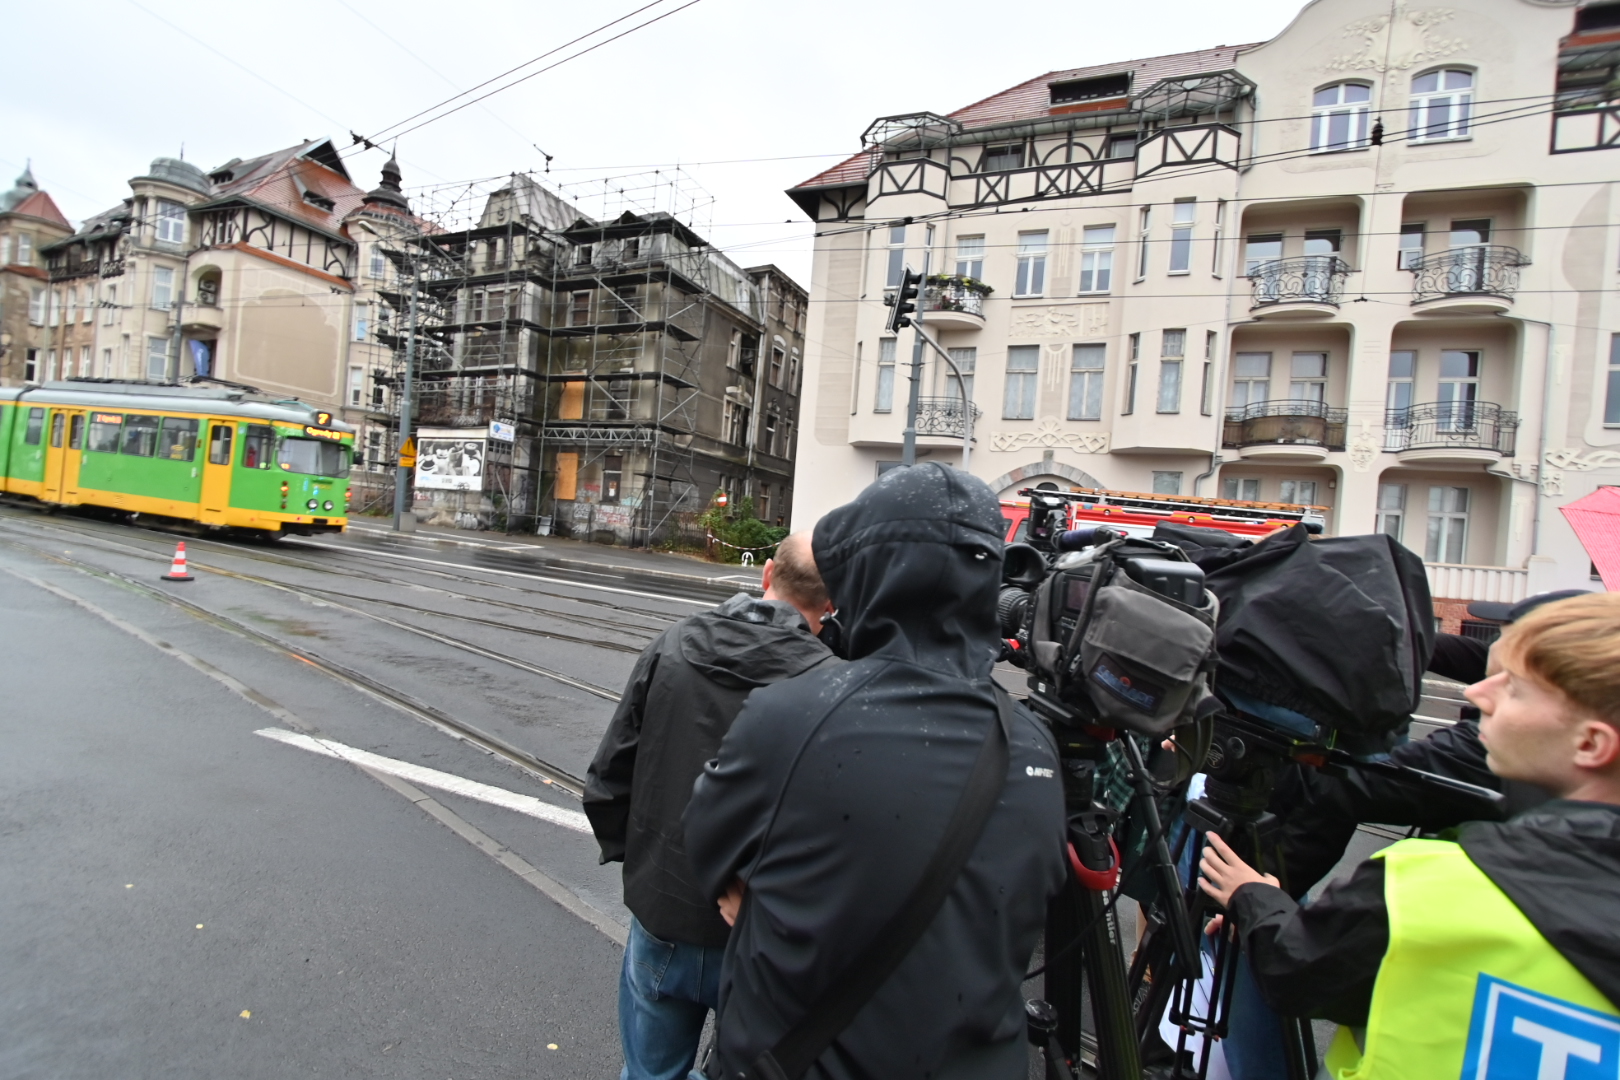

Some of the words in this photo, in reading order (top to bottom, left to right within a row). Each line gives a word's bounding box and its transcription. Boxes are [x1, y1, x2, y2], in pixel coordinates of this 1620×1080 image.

[318, 413, 329, 425] 7
[1102, 889, 1116, 945] sahtler
[1512, 1015, 1602, 1080] T
